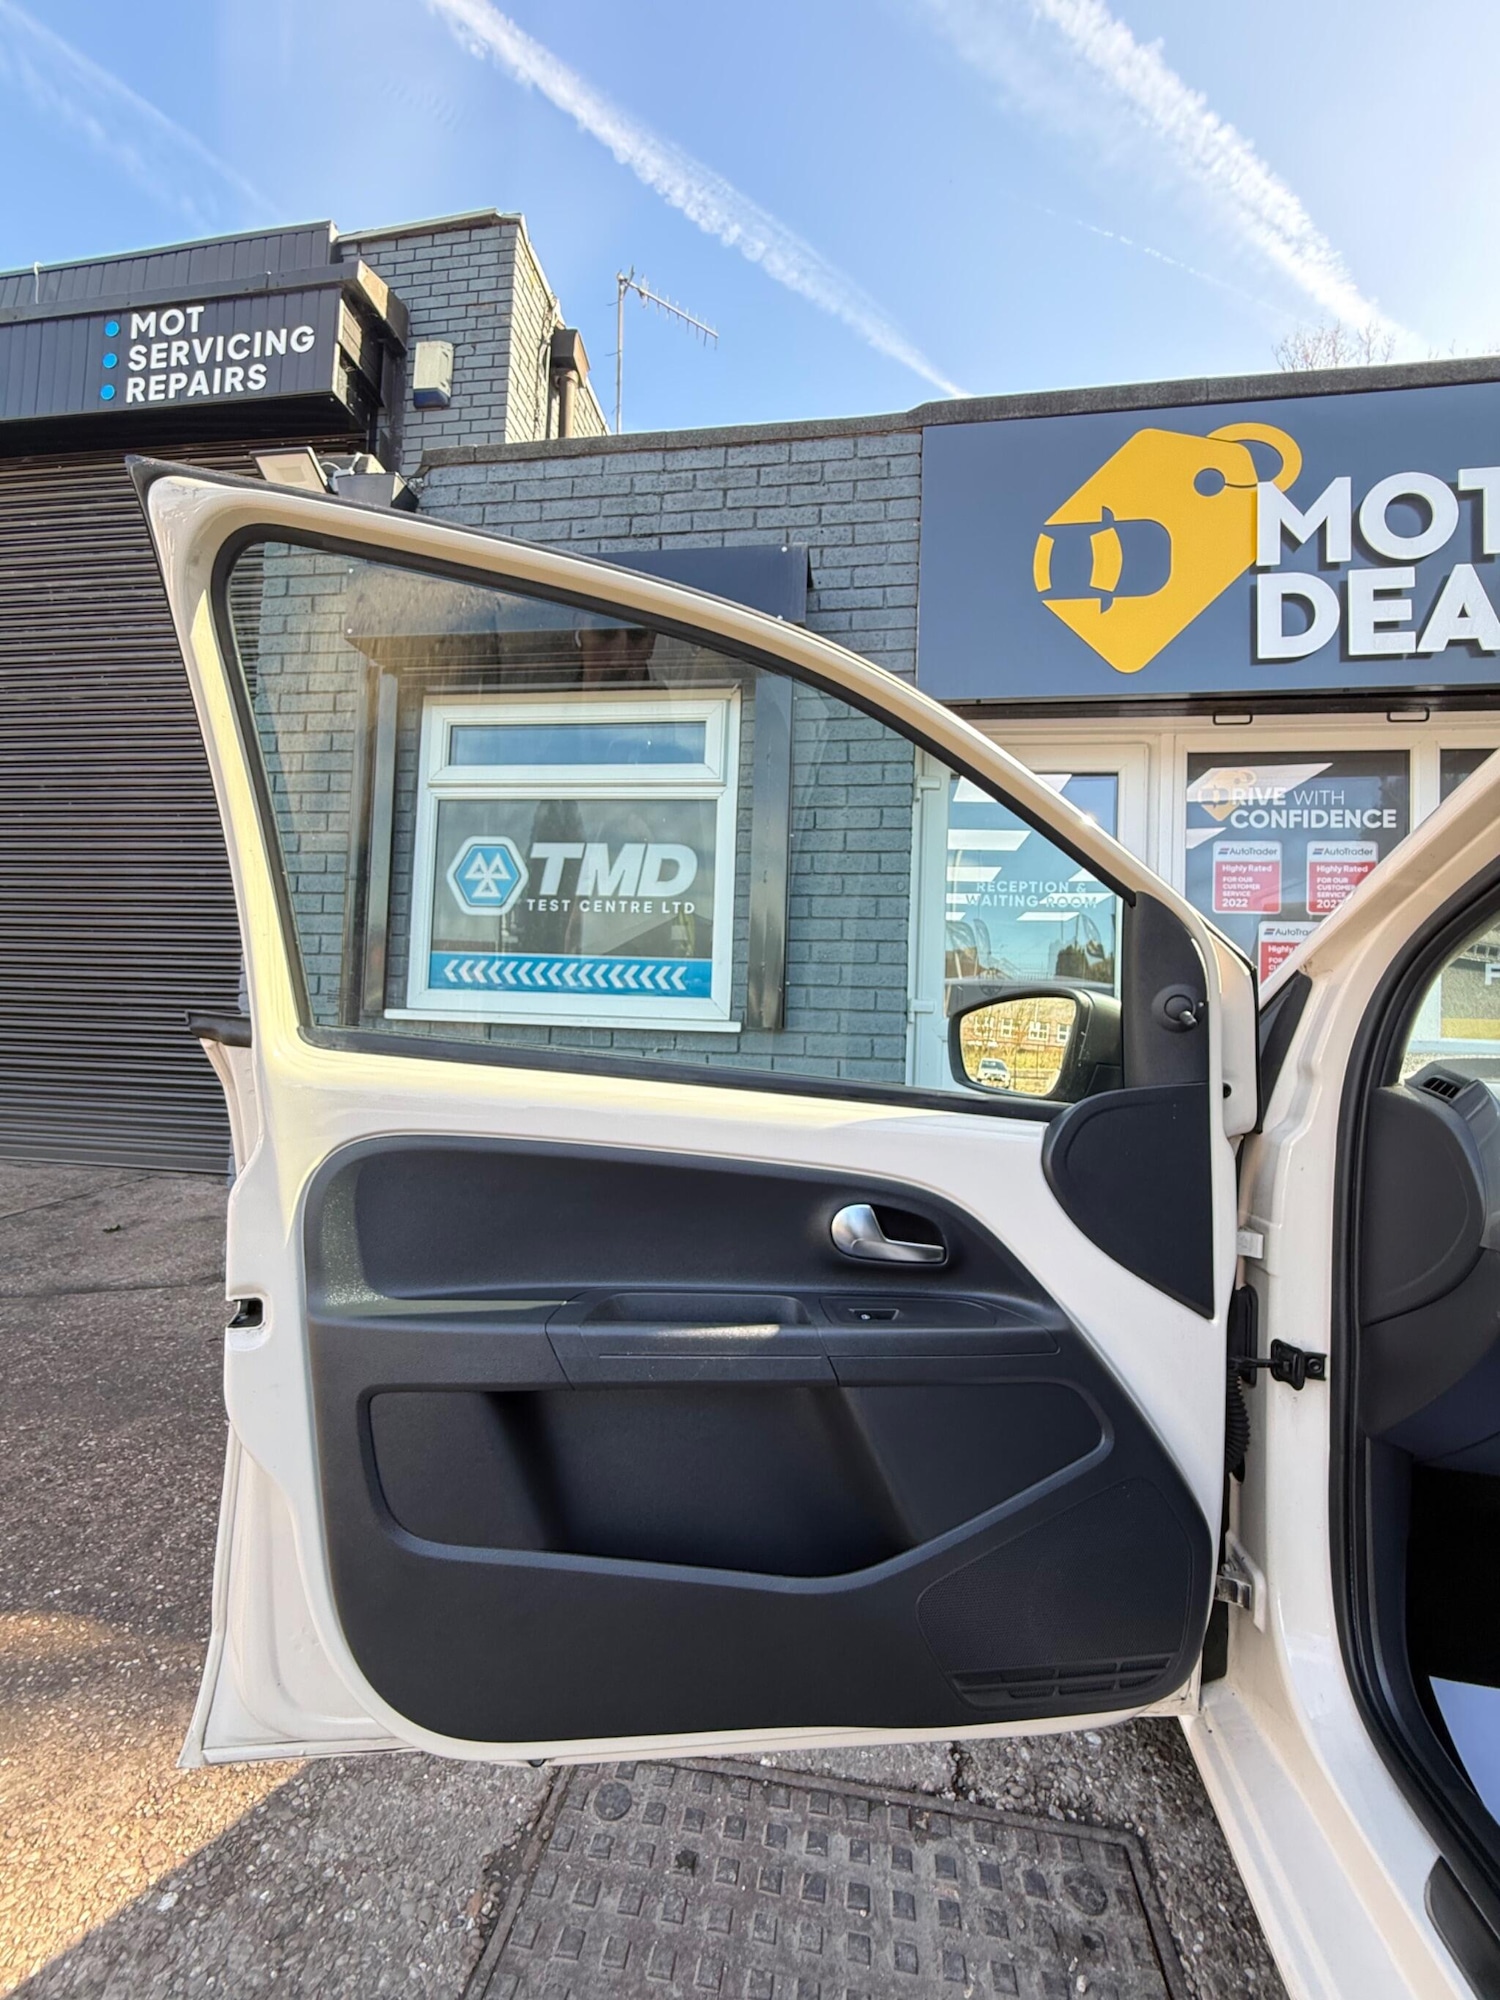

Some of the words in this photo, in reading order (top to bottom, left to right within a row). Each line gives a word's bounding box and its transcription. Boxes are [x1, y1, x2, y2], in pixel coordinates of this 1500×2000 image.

[130, 306, 204, 340] MOT
[127, 325, 315, 372] SERVICING
[126, 363, 267, 403] REPAIRS
[1256, 466, 1500, 566] MOT
[1293, 790, 1345, 806] WITH
[1230, 809, 1397, 829] CONFIDENCE
[1229, 847, 1278, 856] AutoTrader
[1324, 847, 1373, 856] AutoTrader
[530, 842, 698, 897] TMD
[1222, 865, 1247, 873] Highly
[1316, 865, 1342, 874] Highly
[1343, 865, 1368, 873] Rated
[976, 881, 1069, 893] RECEPTION
[1076, 883, 1087, 892] &
[527, 899, 570, 912] TEST
[579, 900, 652, 914] CENTRE
[662, 902, 696, 915] LTD
[966, 894, 1038, 907] WAITING
[1046, 896, 1097, 908] ROOM
[1222, 898, 1249, 908] 2022
